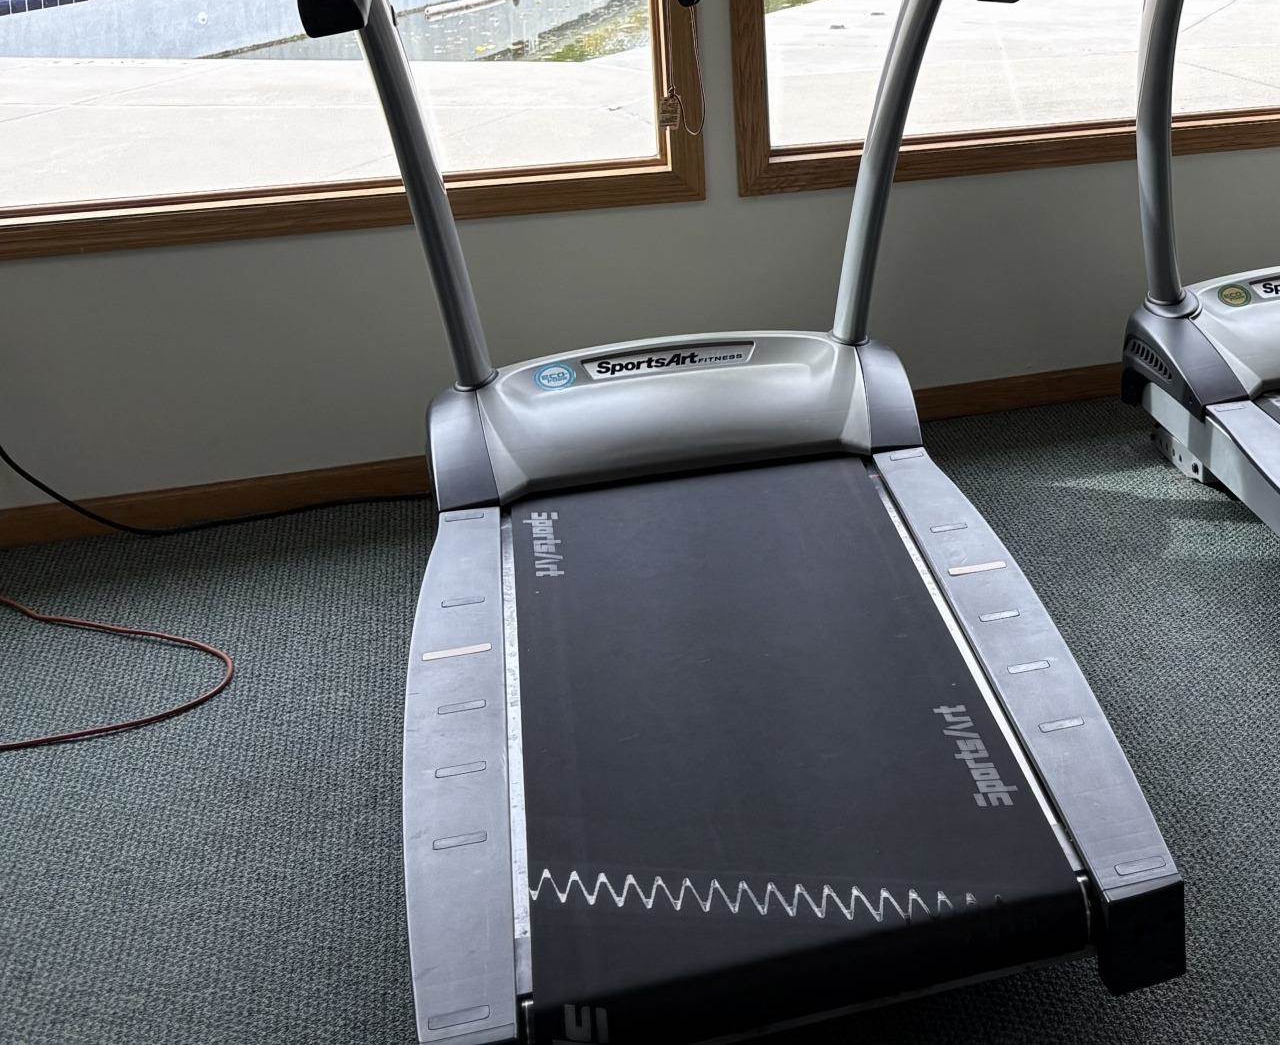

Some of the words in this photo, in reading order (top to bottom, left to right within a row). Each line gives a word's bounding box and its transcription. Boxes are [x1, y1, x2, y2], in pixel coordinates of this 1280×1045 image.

[596, 351, 699, 375] SportsArt
[698, 353, 743, 363] FITNESS
[522, 512, 565, 577] SportsArt
[932, 704, 1019, 807] SportsArt
